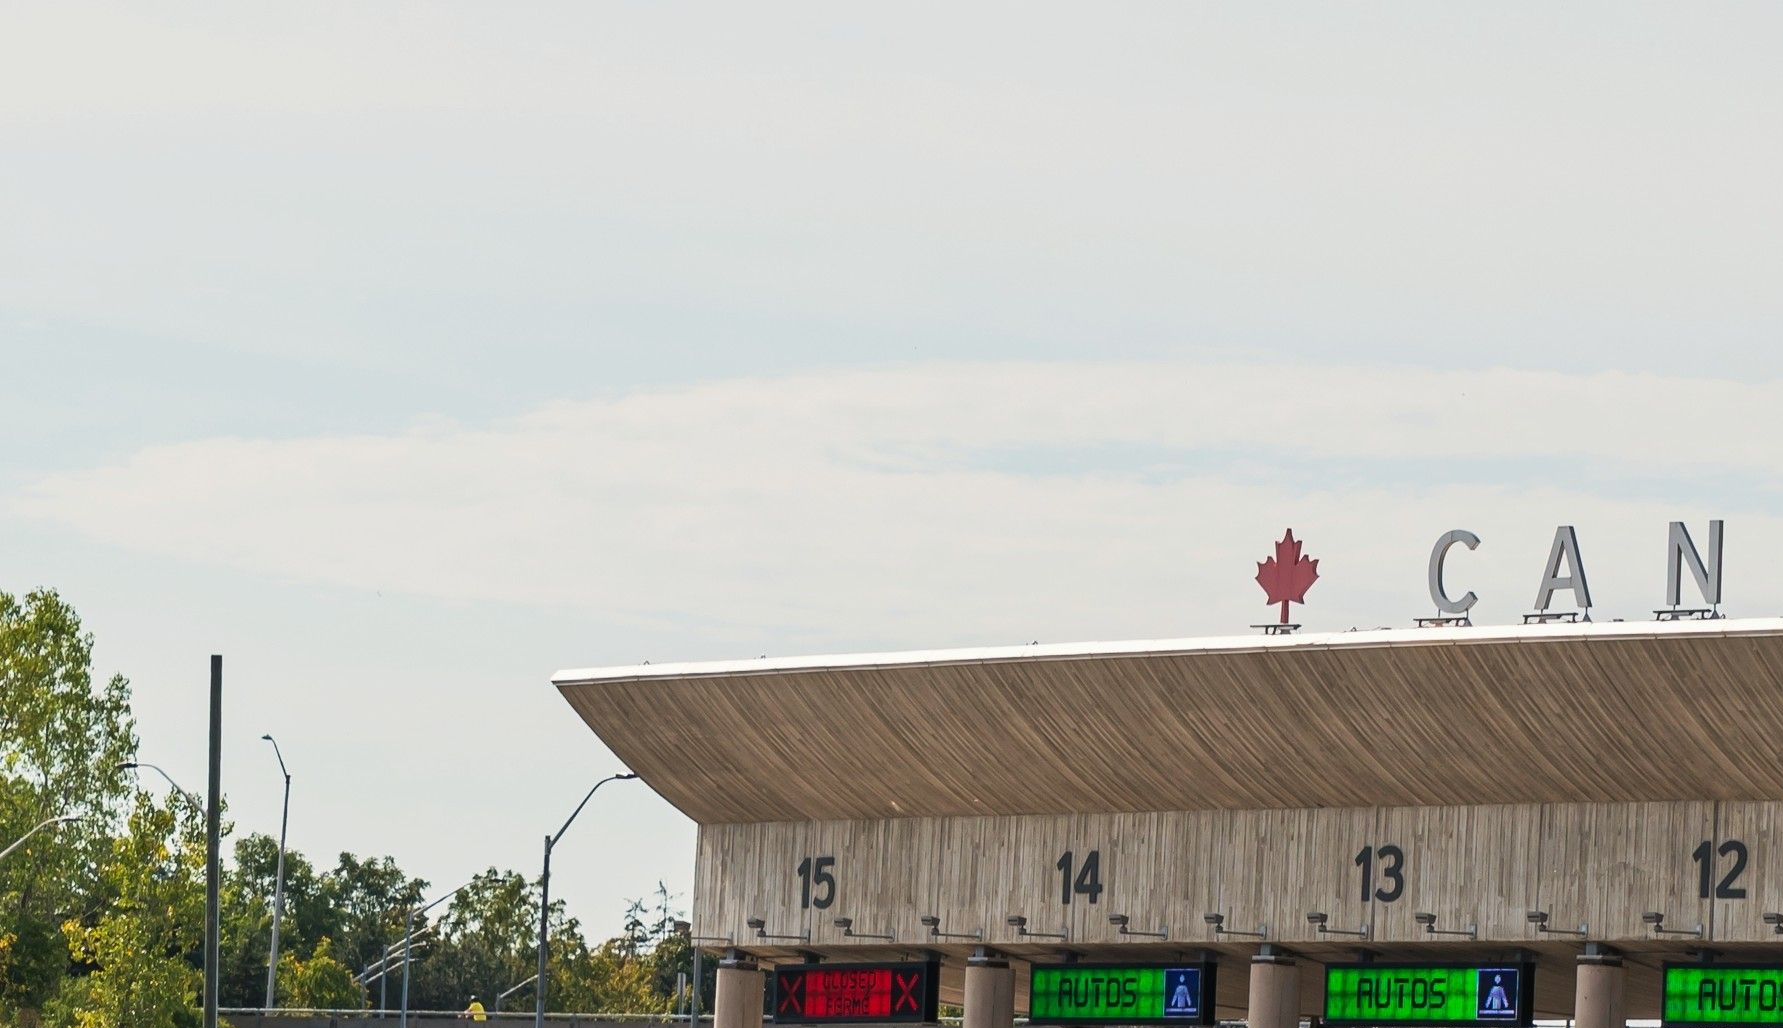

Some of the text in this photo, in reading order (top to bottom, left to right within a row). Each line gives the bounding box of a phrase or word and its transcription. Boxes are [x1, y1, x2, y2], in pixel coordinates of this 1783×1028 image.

[797, 856, 836, 909] 15
[1057, 850, 1103, 905] 14
[1355, 845, 1404, 902] 13
[1692, 840, 1748, 899] 12
[823, 972, 877, 990] CLOSED
[1059, 977, 1137, 1009] AUTOS
[1357, 977, 1447, 1010] AUTOS
